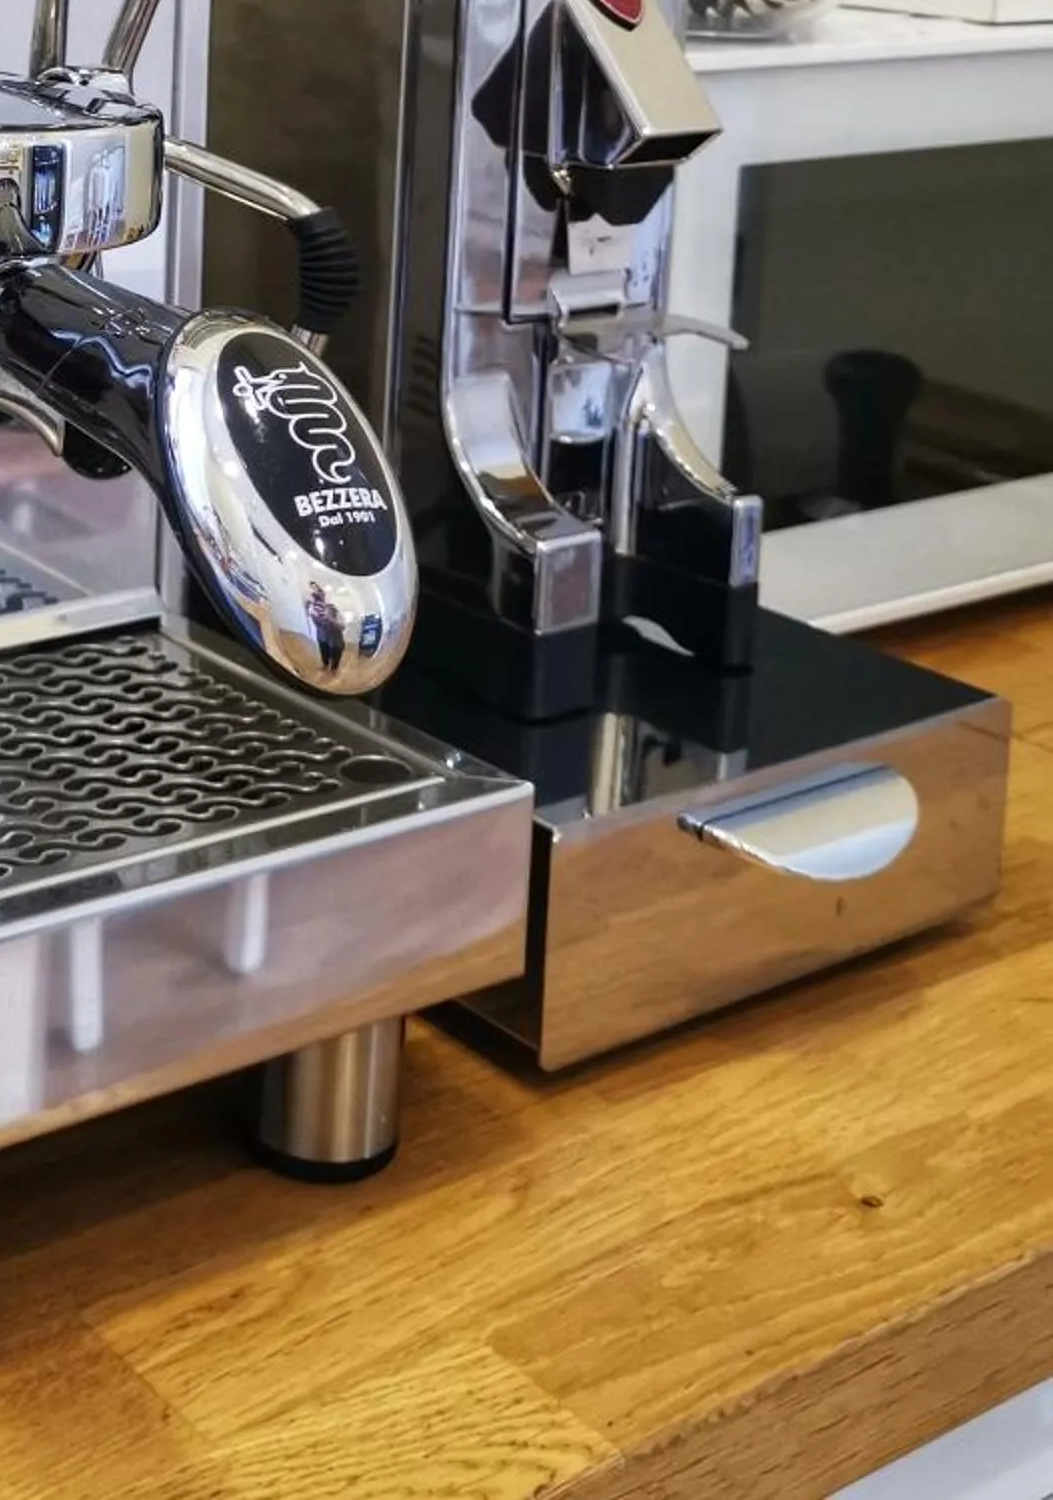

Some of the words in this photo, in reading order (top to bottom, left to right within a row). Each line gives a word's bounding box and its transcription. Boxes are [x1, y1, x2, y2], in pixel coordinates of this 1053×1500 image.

[294, 486, 388, 517] BEZZERA
[318, 512, 344, 528] Dal
[347, 510, 376, 524] 1901
